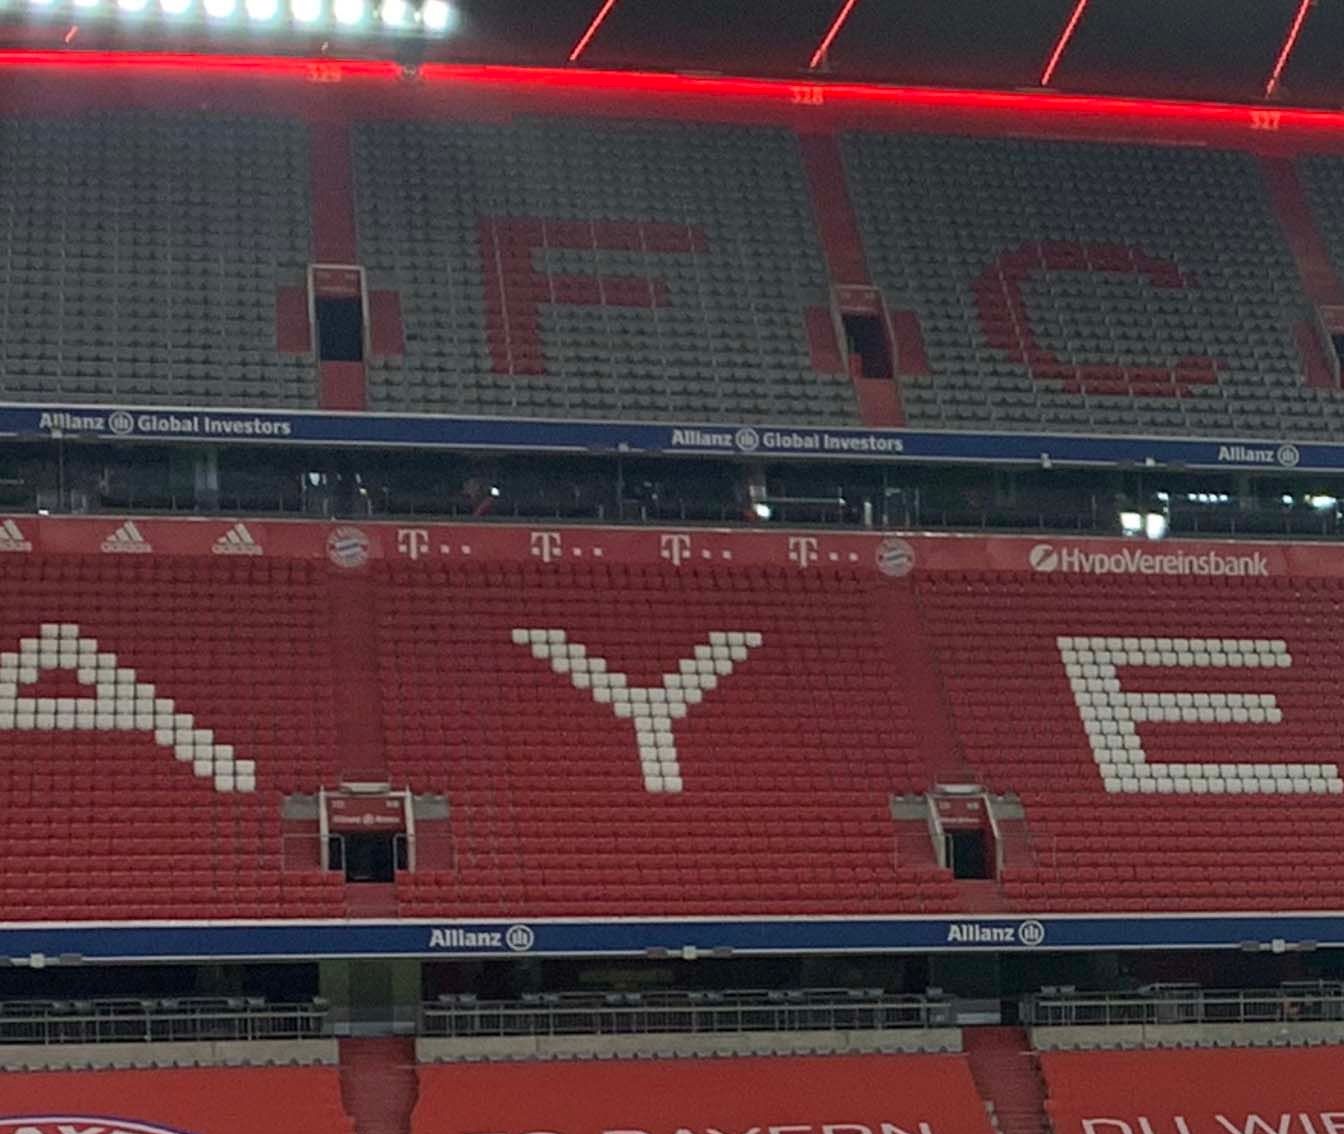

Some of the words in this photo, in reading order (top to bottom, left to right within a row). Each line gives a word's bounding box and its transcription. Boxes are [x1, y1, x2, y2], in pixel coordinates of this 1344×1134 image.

[39, 412, 105, 432] Allianz
[137, 414, 199, 433] Global
[204, 415, 292, 437] Investors
[671, 428, 733, 449] Allianz
[762, 432, 821, 450] Global
[825, 434, 904, 453] Investors
[1217, 444, 1275, 464] Allianz
[429, 927, 501, 948] Allianz
[947, 923, 1015, 943] Allianz
